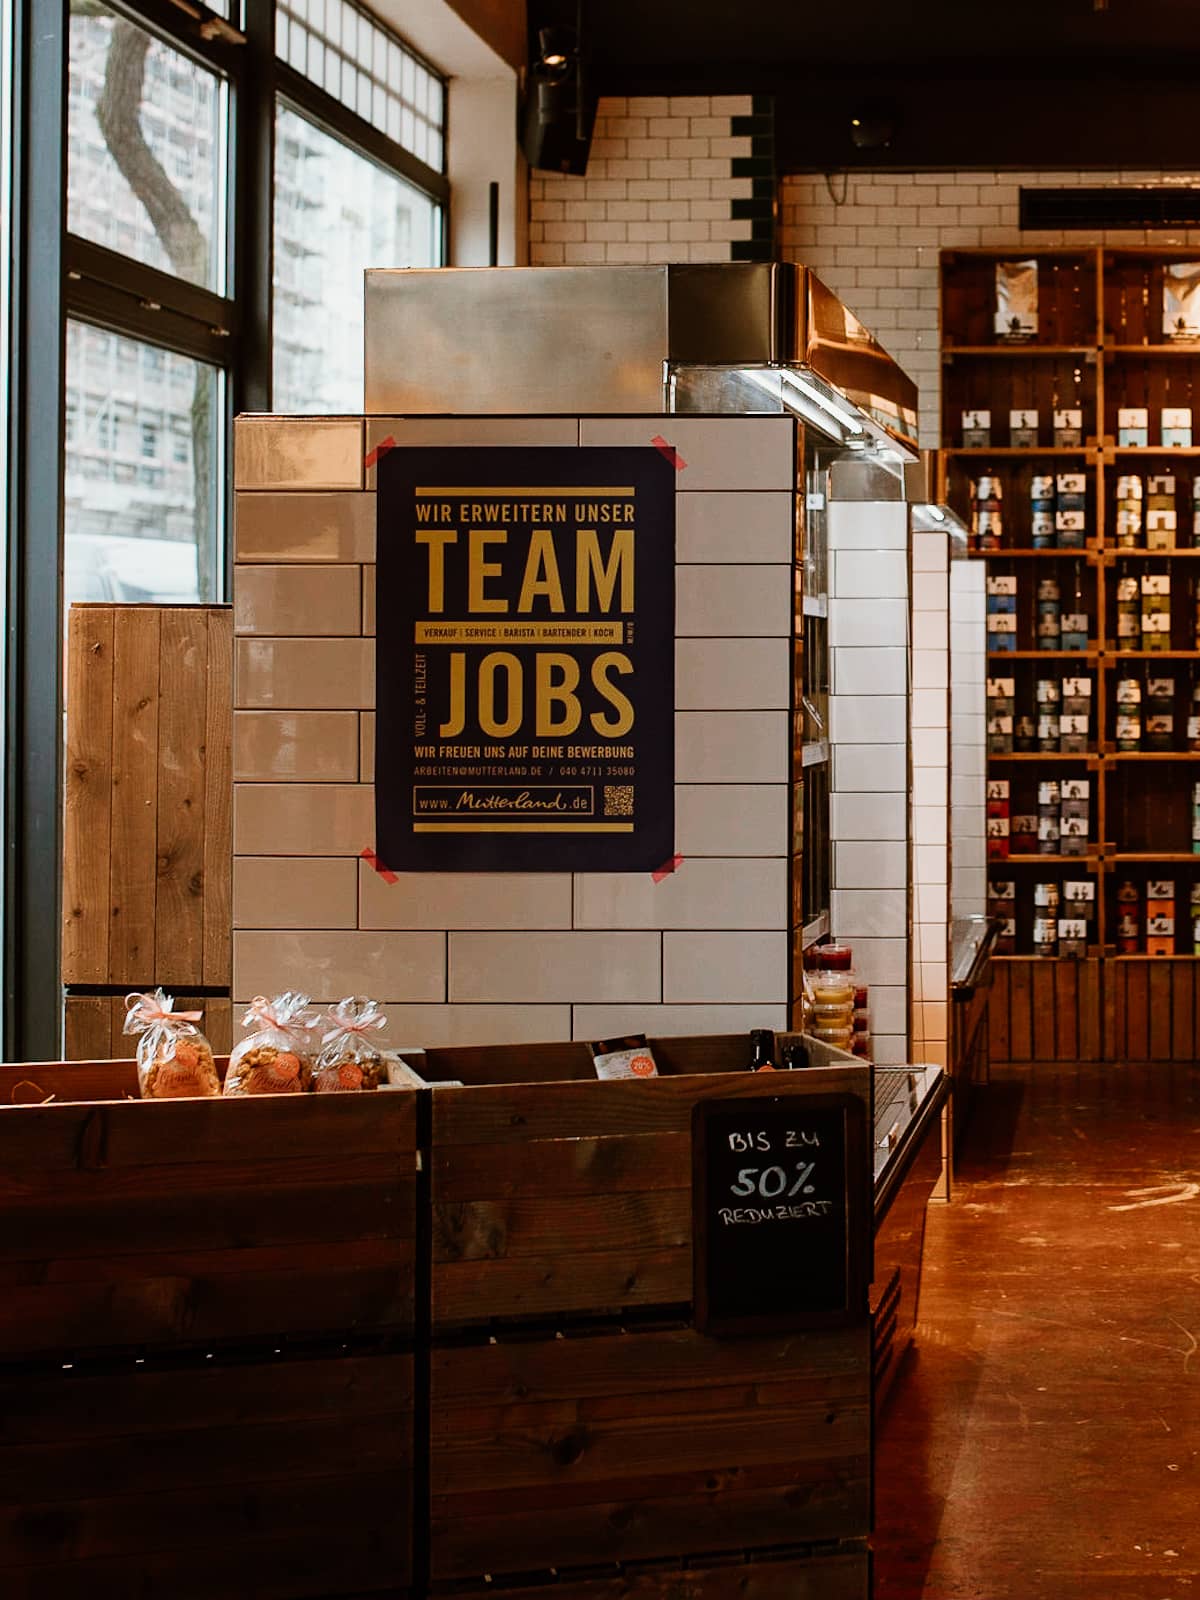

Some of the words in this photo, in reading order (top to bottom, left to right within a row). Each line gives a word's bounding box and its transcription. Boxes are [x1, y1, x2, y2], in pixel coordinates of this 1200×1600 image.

[416, 504, 452, 522] WIR
[460, 504, 567, 522] ERWEITERN
[575, 504, 635, 522] UNSER
[415, 530, 635, 613] TEAM
[424, 628, 457, 638] VERKAUF
[465, 628, 497, 638] SERVICE
[504, 628, 536, 638] BARISTA
[543, 628, 587, 638] BARTENDER
[593, 628, 614, 638] KOCH
[415, 654, 426, 694] TEILZEIT
[416, 697, 426, 705] &
[440, 651, 635, 737] JOBS
[415, 706, 426, 737] VOLL-
[414, 746, 436, 759] WIR
[440, 746, 481, 759] FREUEN
[484, 746, 505, 759] UNS
[508, 746, 529, 759] AUF
[532, 746, 564, 759] DEINE
[568, 746, 635, 759] BEWERBUNG
[560, 766, 577, 777] 040
[728, 1131, 771, 1152] BIS
[785, 1130, 820, 1147] ZU
[730, 1161, 816, 1198] 50%
[717, 1200, 832, 1226] REDUZIERT
